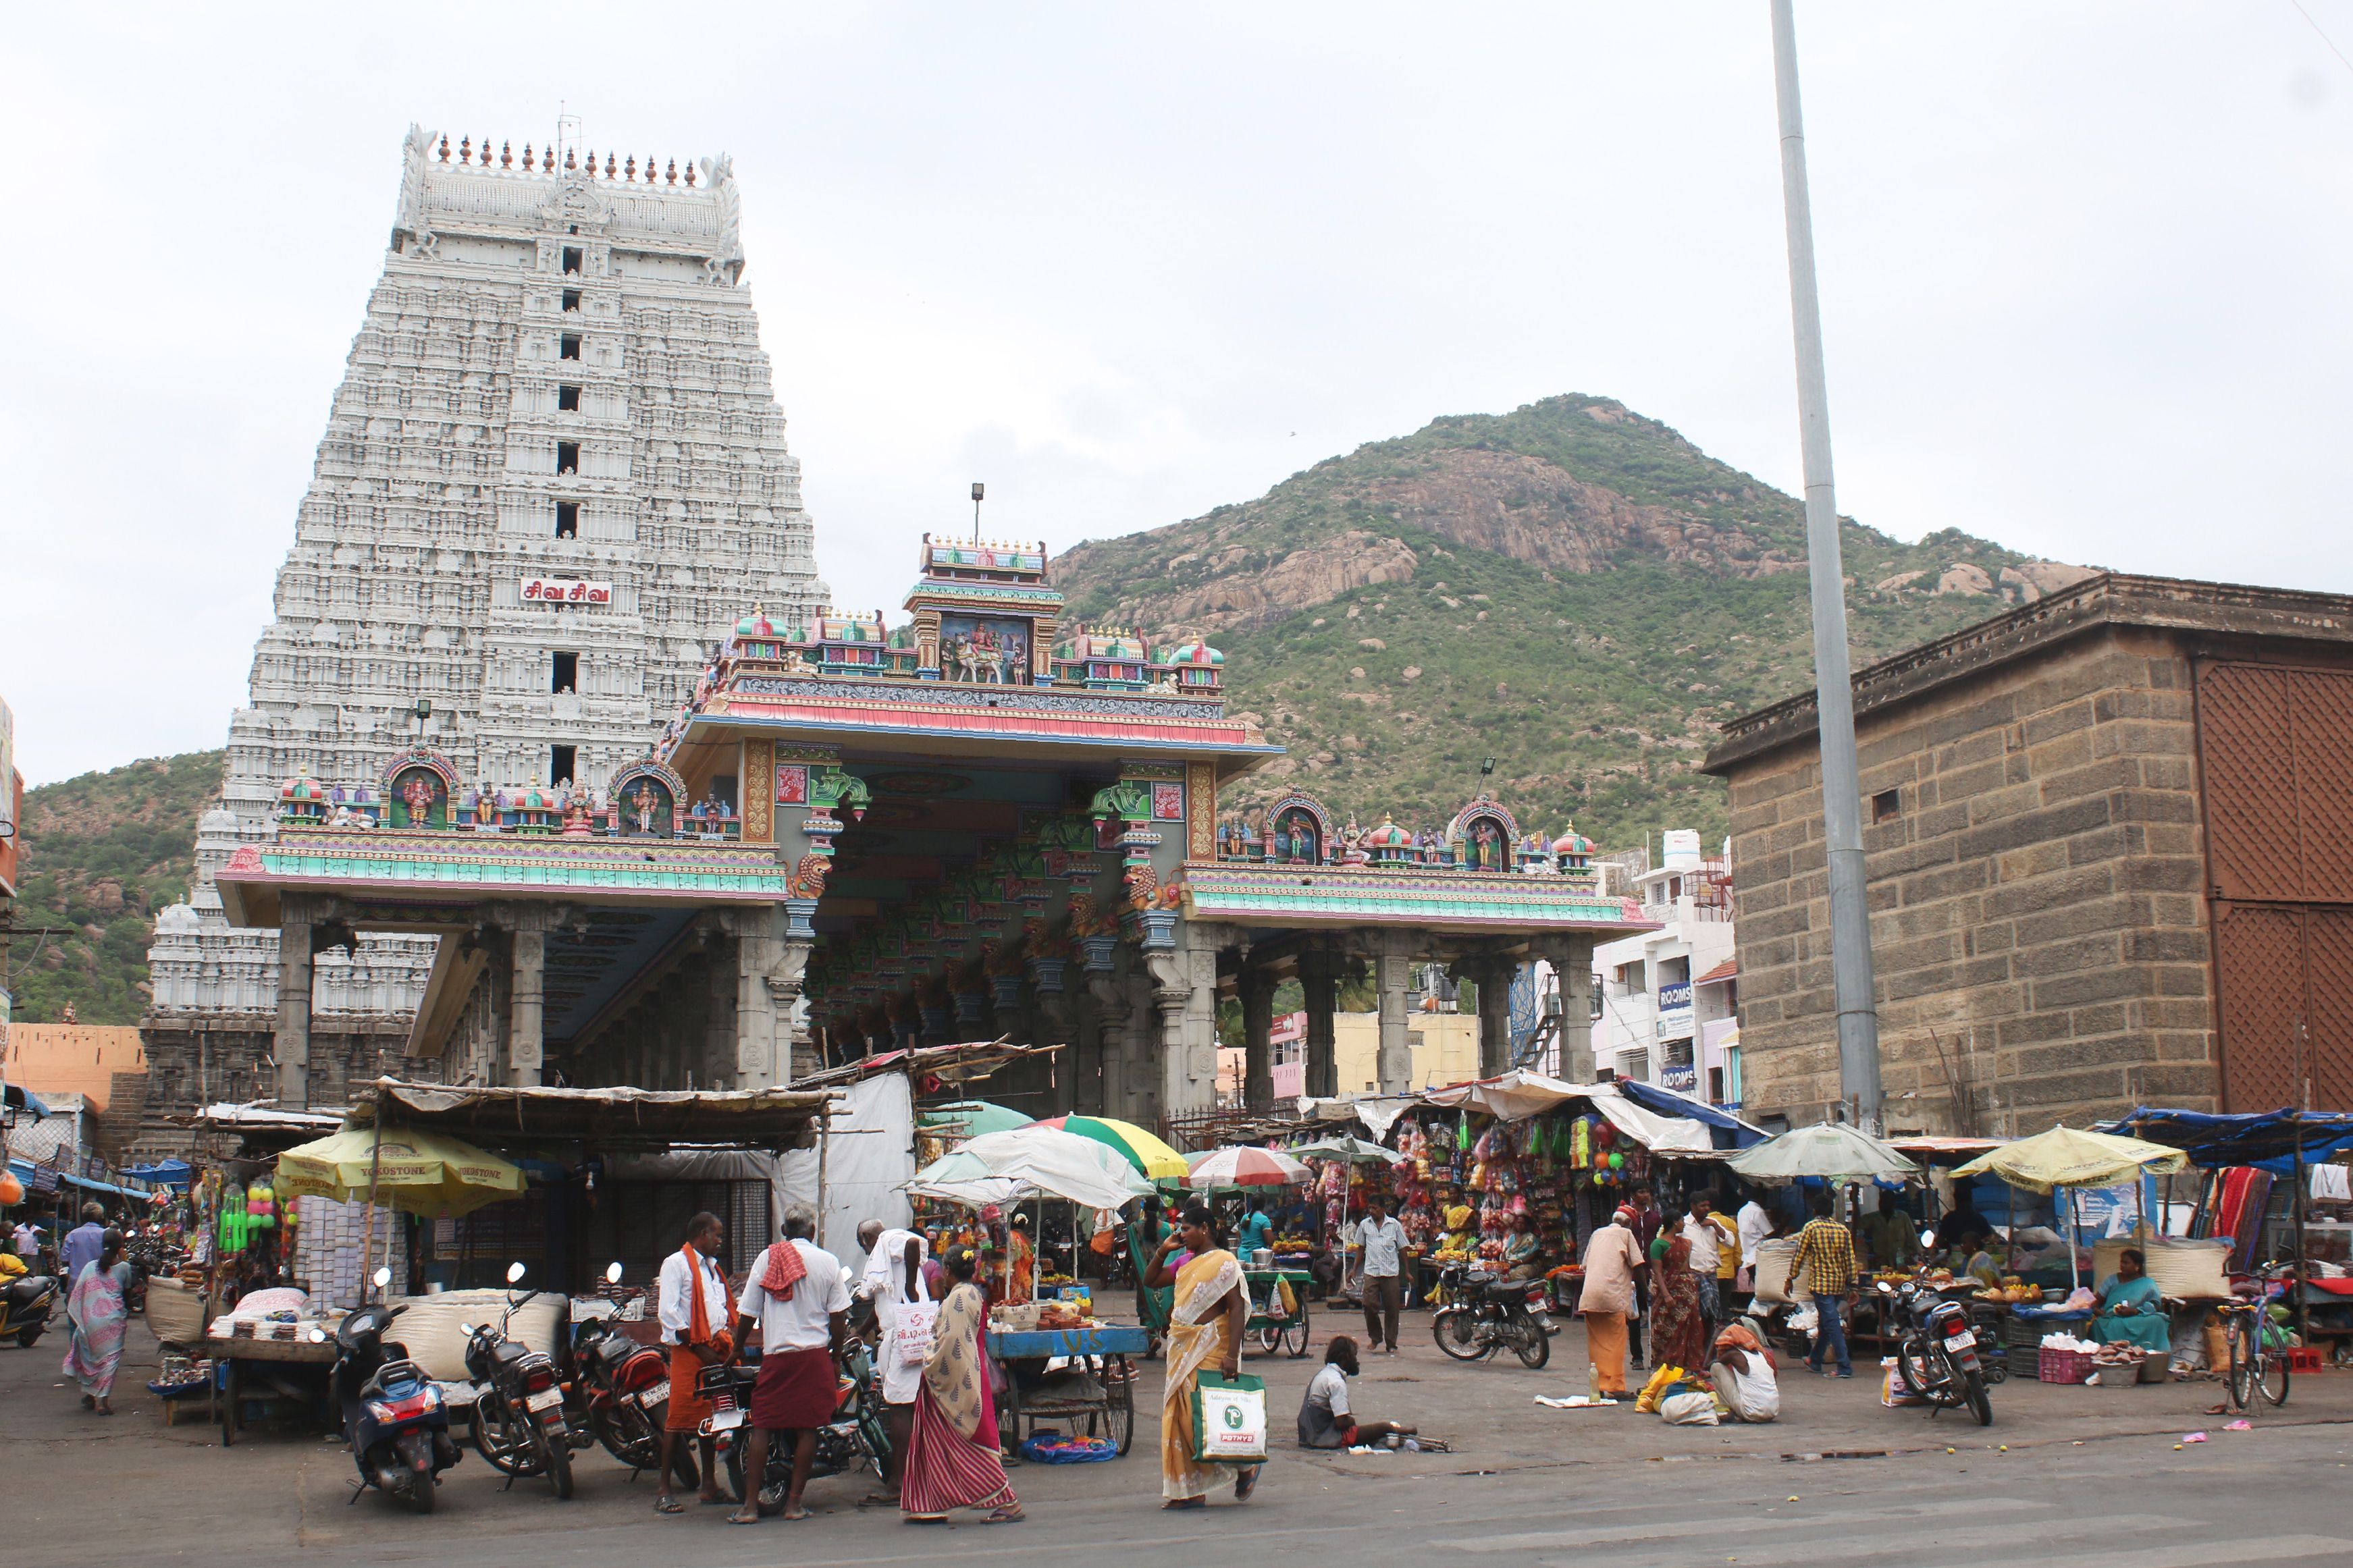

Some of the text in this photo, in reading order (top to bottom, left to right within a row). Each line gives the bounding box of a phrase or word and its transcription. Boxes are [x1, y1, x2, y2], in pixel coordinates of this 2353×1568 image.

[524, 580, 609, 602] சிவ சிவ
[1660, 986, 1691, 1006] ROOMS
[1662, 1070, 1693, 1087] ROOMS
[1221, 1434, 1253, 1442] POTHYS
